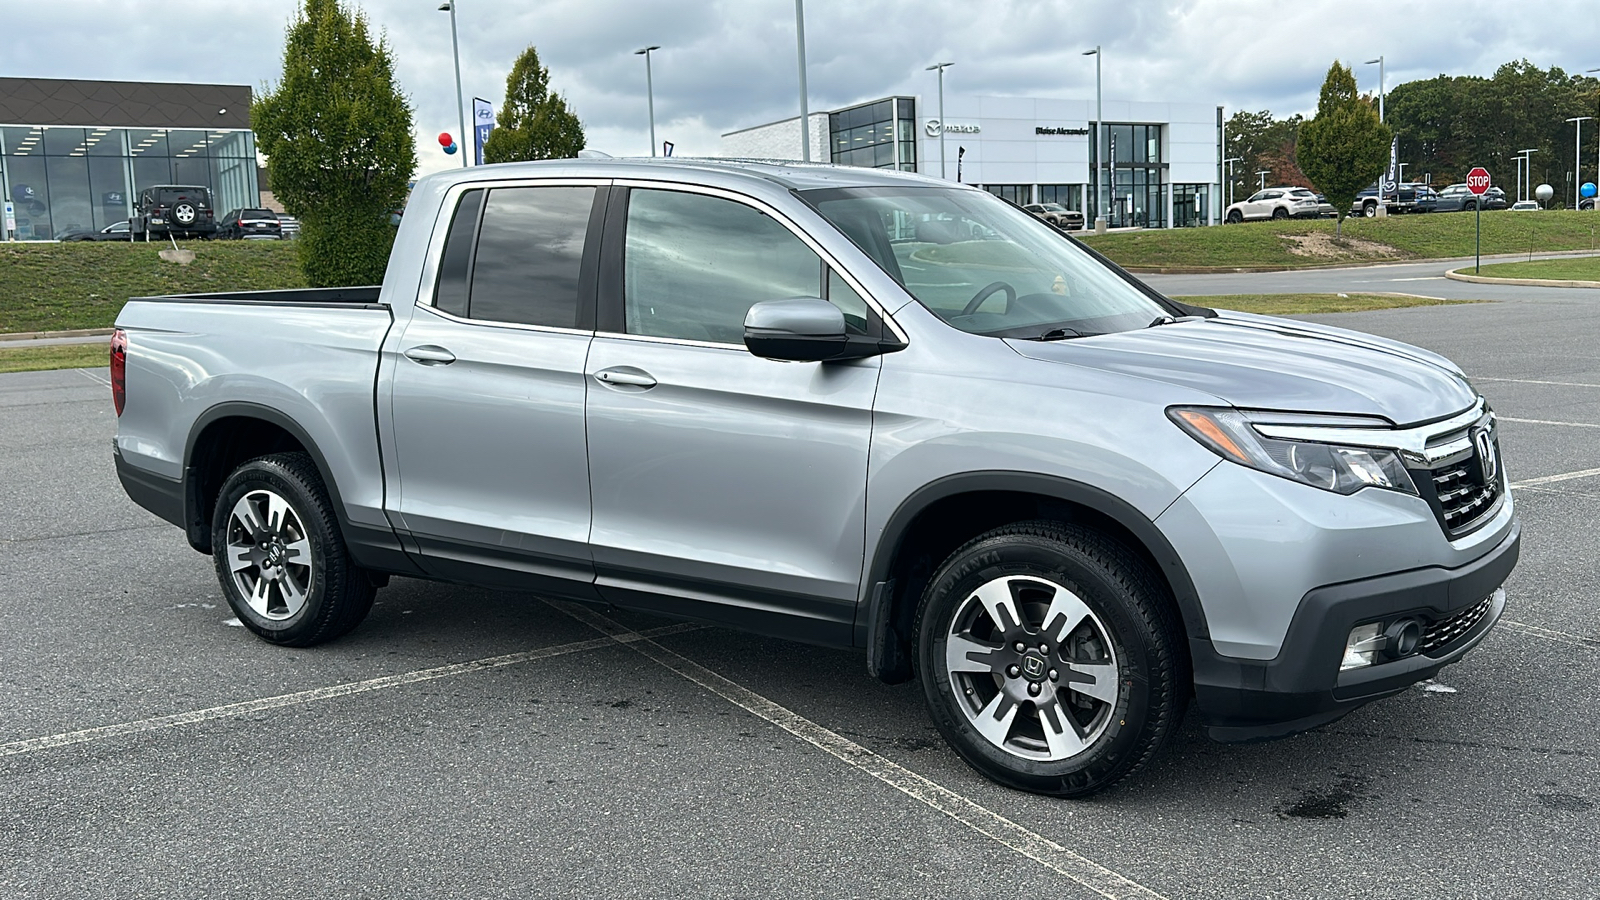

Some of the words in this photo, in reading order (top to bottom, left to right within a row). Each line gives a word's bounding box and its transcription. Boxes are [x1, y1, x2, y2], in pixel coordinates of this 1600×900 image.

[1035, 126, 1056, 135] Blaise
[1057, 127, 1089, 136] Alexander
[1468, 175, 1489, 187] STOP
